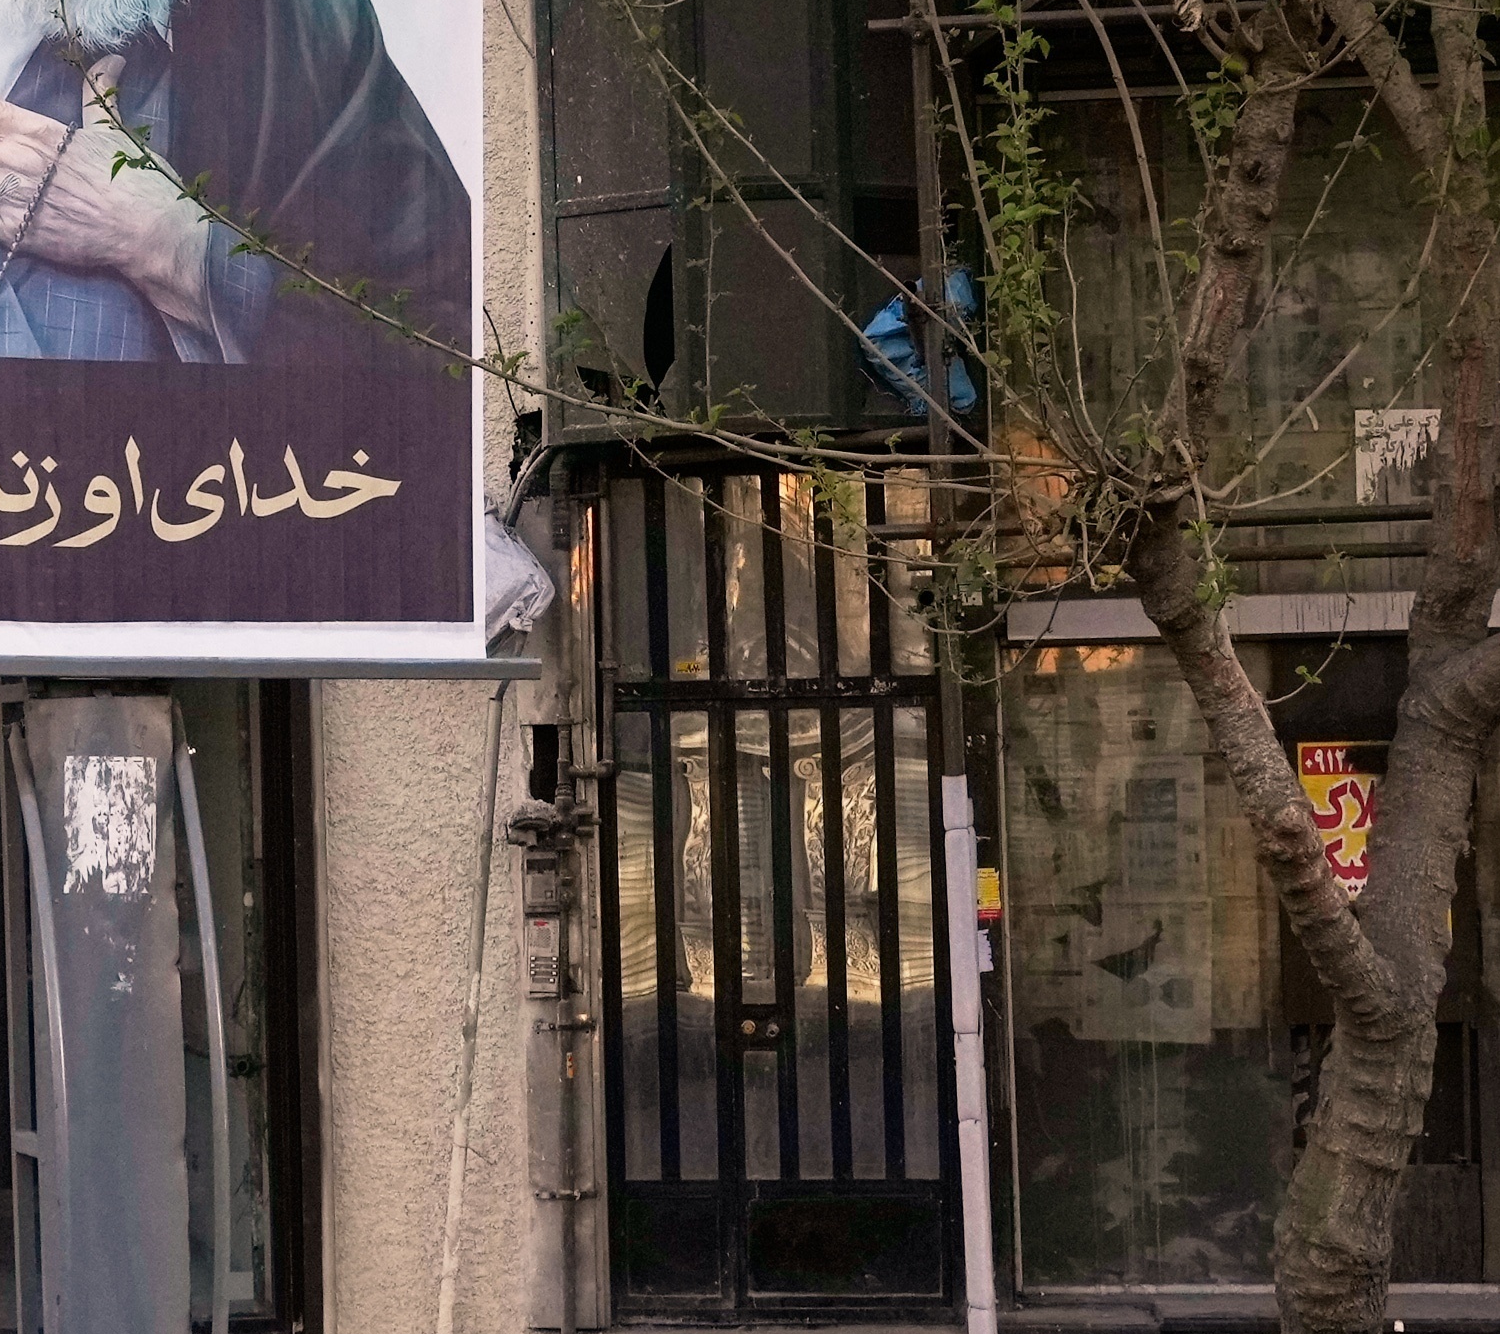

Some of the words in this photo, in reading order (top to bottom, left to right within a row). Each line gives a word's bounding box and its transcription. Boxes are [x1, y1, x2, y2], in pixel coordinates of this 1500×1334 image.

[52, 435, 144, 549] او
[151, 436, 401, 543] خدای
[1305, 748, 1354, 773] ۰۹۱۲
